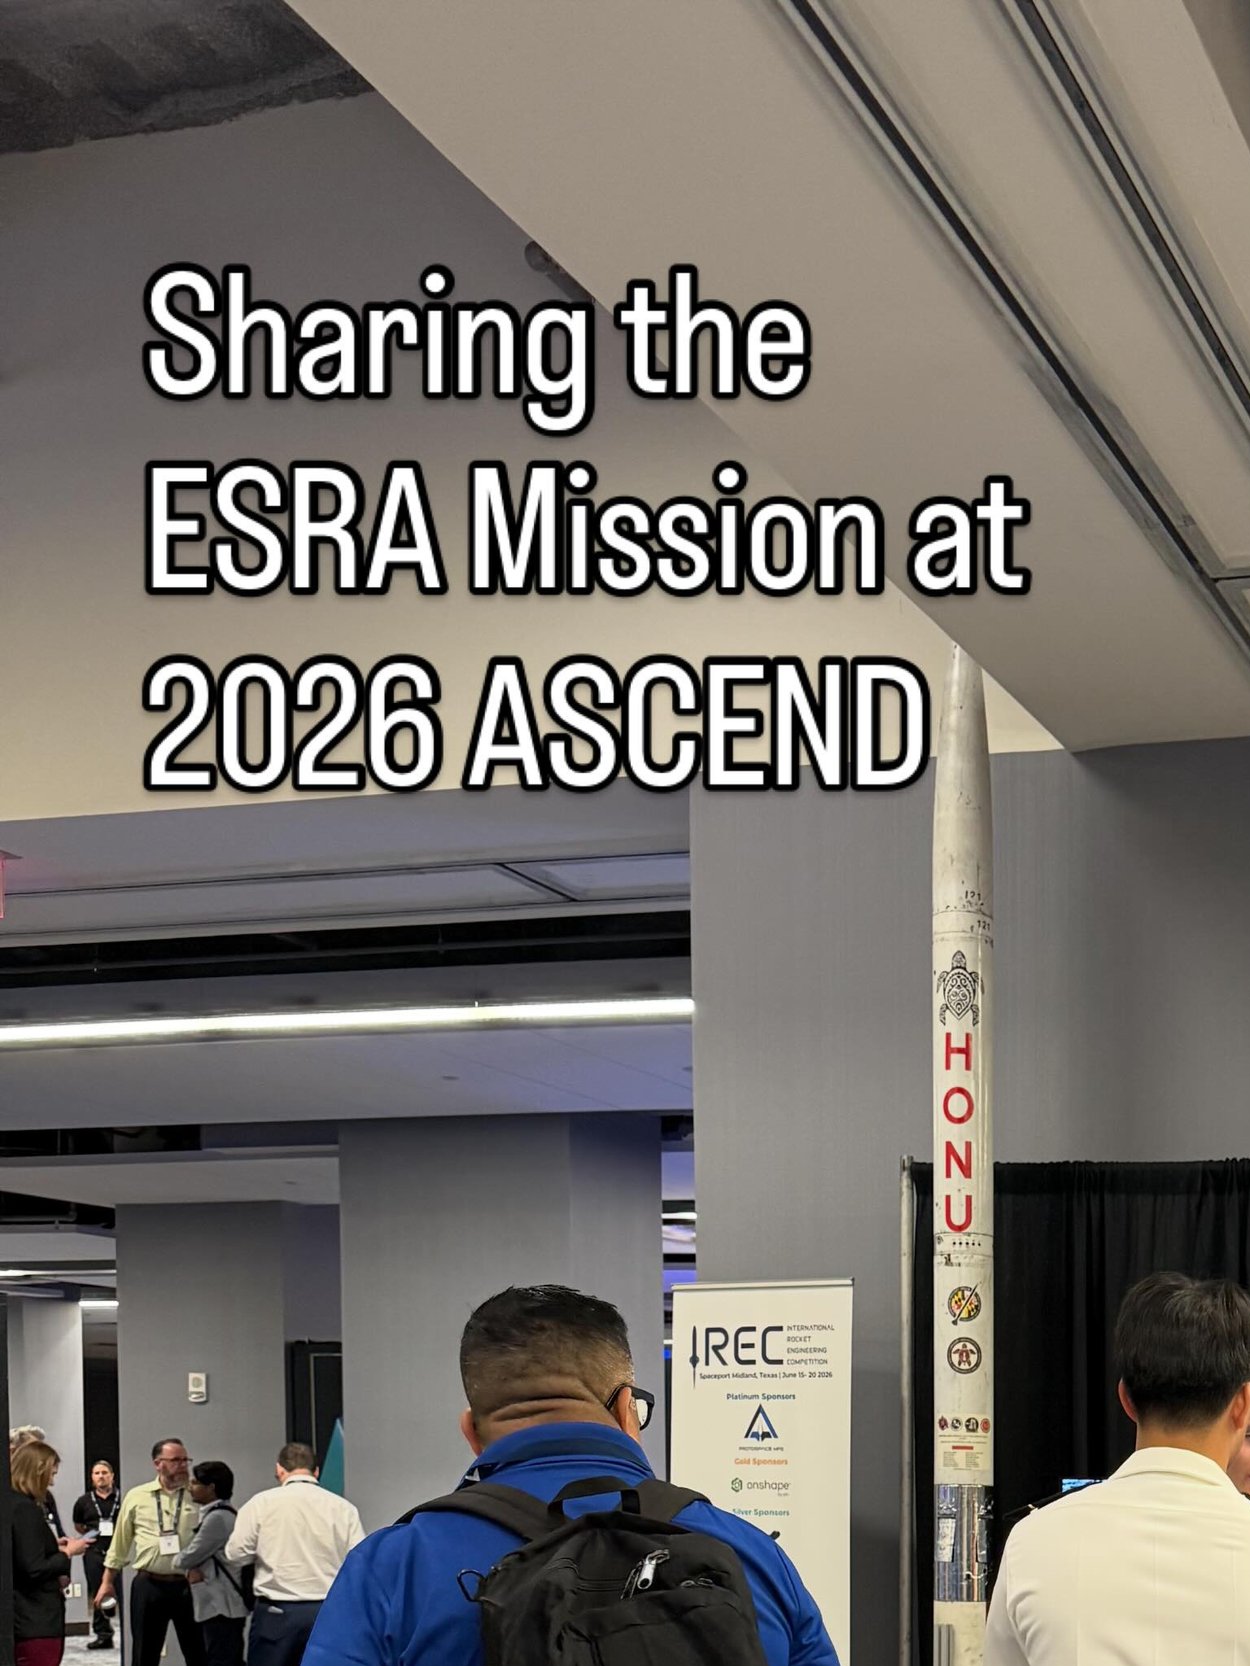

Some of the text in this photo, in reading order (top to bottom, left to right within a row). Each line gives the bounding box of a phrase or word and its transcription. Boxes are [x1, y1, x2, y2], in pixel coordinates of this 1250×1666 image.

[942, 1032, 975, 1233] HONU
[786, 1324, 835, 1332] INTERNATIONAL
[786, 1335, 812, 1343] ROCKET
[786, 1358, 828, 1366] COMPETITION
[699, 1373, 731, 1382] Spaceport
[732, 1372, 758, 1380] Midland,
[782, 1371, 797, 1379] June
[808, 1371, 817, 1379] 20
[761, 1393, 796, 1401] Sponsors
[752, 1458, 788, 1466] Sponsors
[746, 1480, 790, 1493] onshape
[753, 1508, 790, 1517] Sponsors
